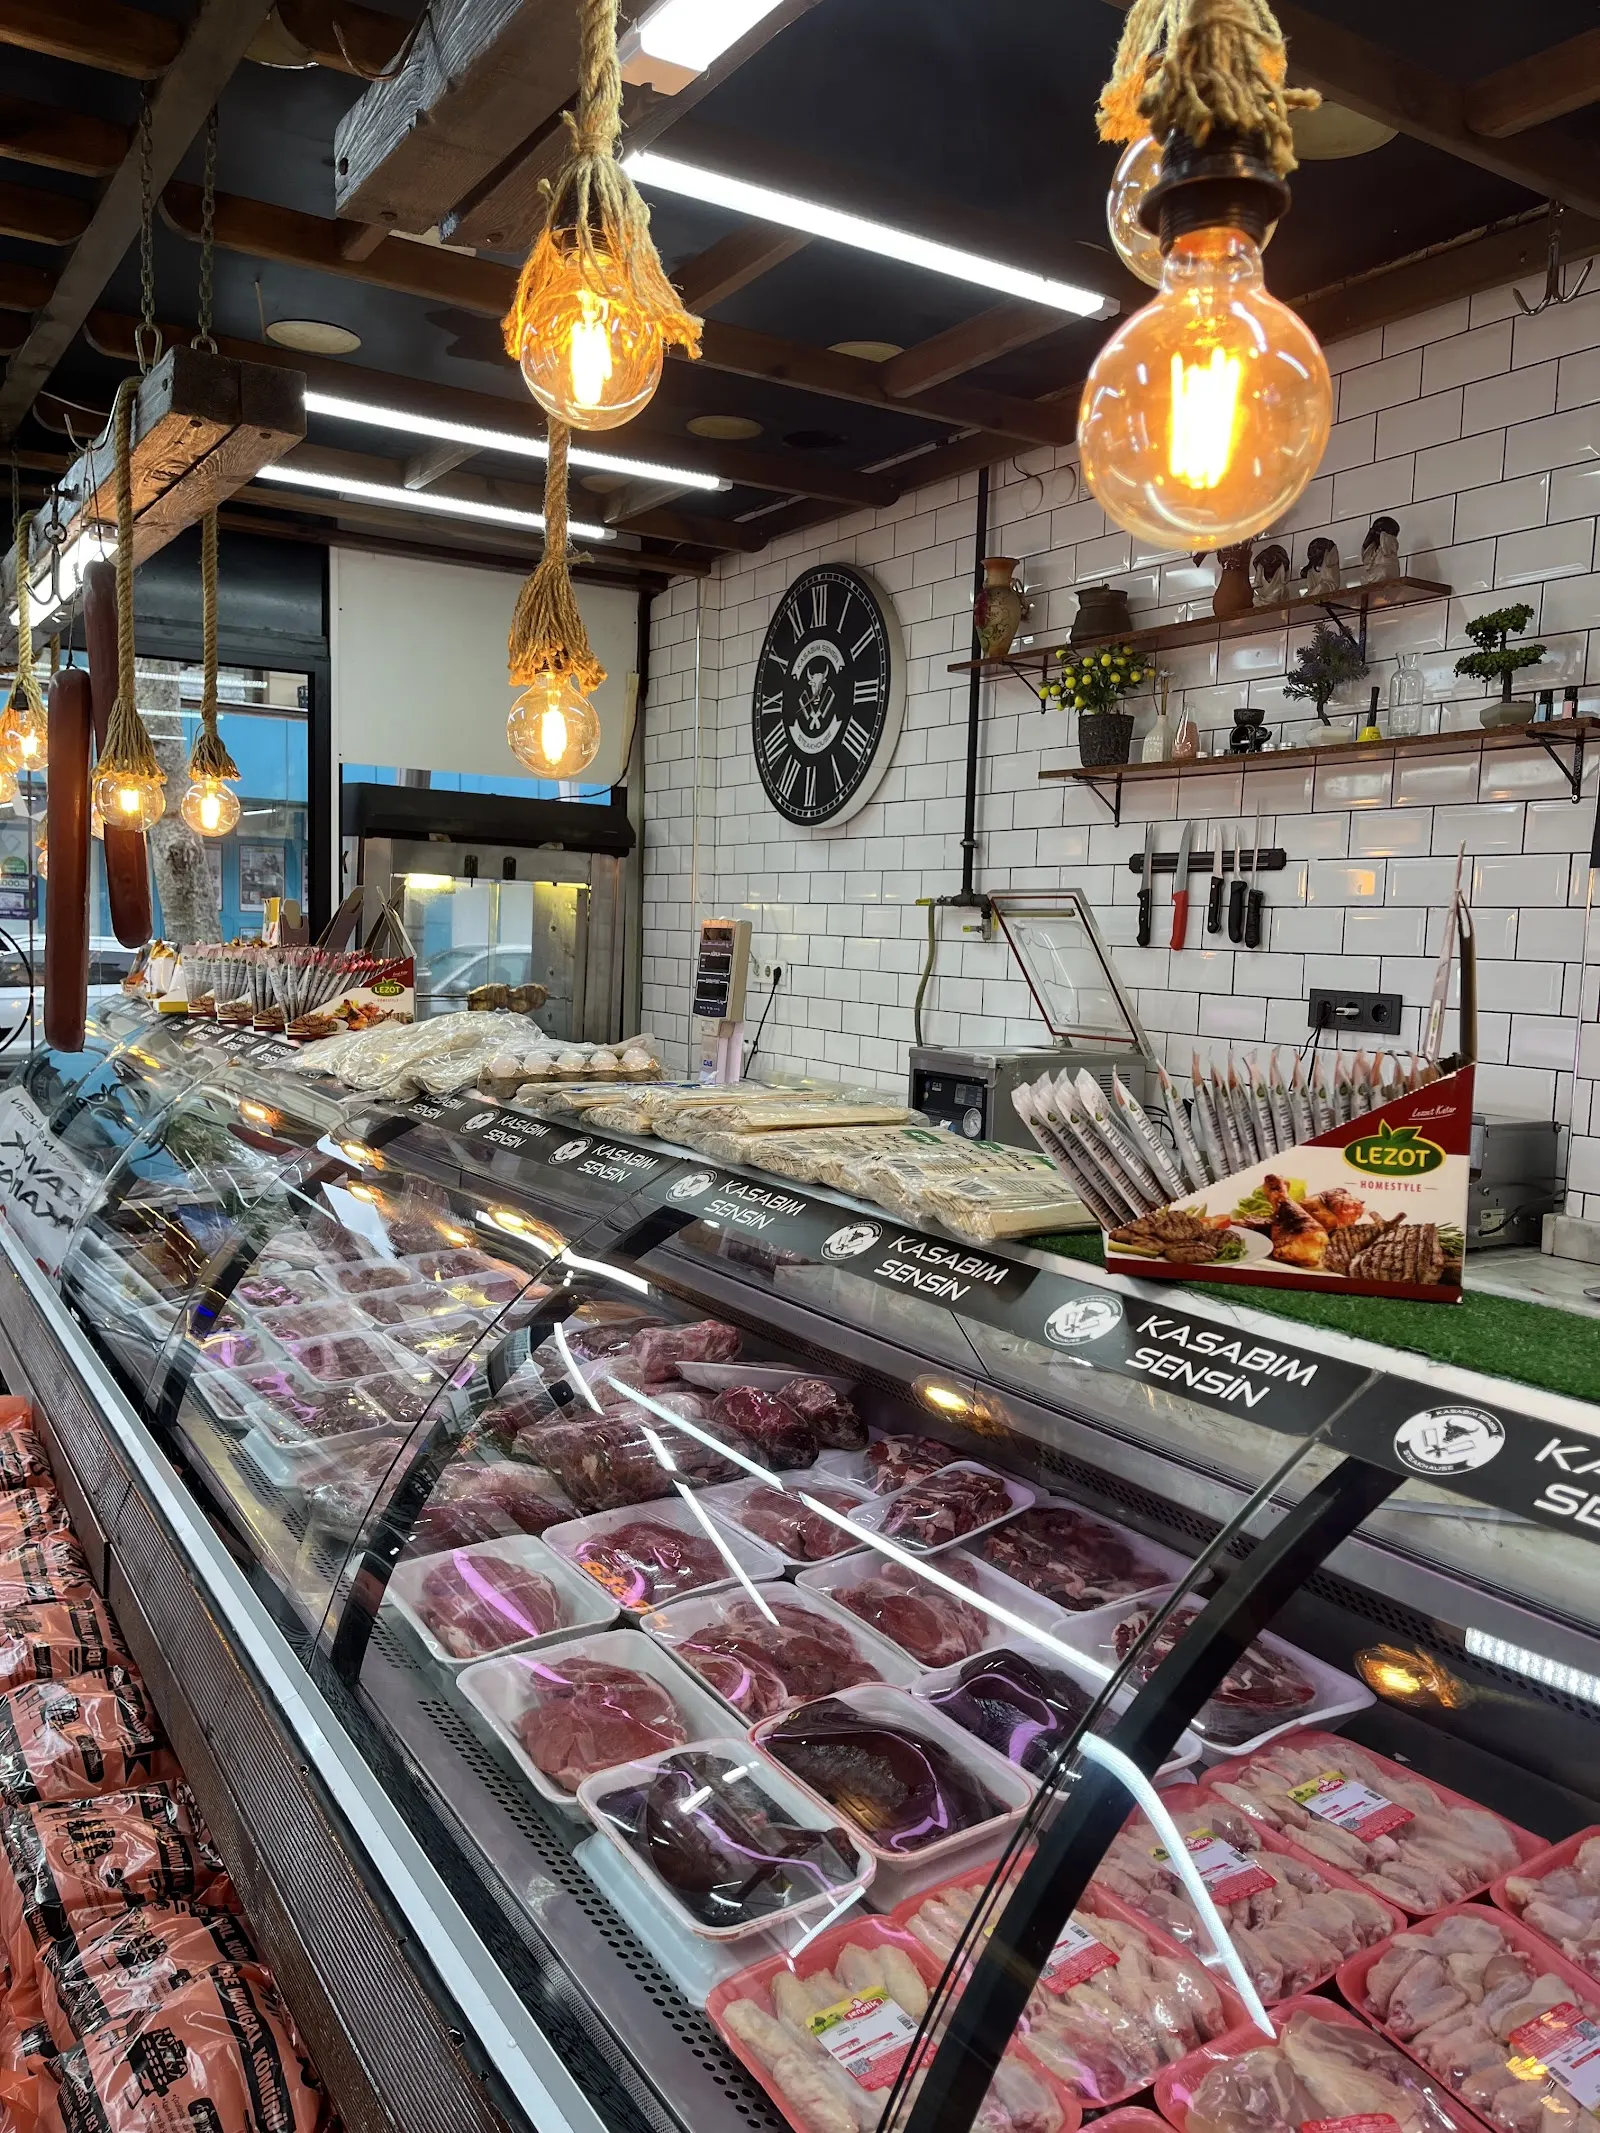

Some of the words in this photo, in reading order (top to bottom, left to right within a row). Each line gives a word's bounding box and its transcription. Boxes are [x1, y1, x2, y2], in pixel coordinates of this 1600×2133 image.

[787, 600, 806, 644] XI
[810, 584, 828, 628] XII
[837, 592, 852, 634] I
[769, 645, 789, 675] X
[850, 625, 876, 661] II
[762, 690, 784, 715] IX
[853, 678, 880, 705] III
[764, 719, 789, 770] VIII
[776, 754, 801, 801] VII
[803, 765, 817, 807] VI
[830, 754, 844, 793] V
[374, 986, 401, 994] LEZOT
[482, 1129, 527, 1149] SENSİN
[497, 1115, 551, 1138] KASABIM
[577, 1160, 632, 1183] SENSİN
[591, 1143, 659, 1171] KASABIM
[1355, 1145, 1431, 1168] LEZOT
[718, 1179, 807, 1217] KASABIM
[1360, 1180, 1422, 1193] HOMESTYLE
[704, 1199, 775, 1230] SENSİN
[887, 1235, 1010, 1285] KASABIM
[873, 1258, 971, 1302] SENSİN
[1136, 1314, 1319, 1387] KASABIM
[1125, 1347, 1270, 1408] SENSİN
[1435, 1407, 1479, 1418] KASABIM
[227, 1986, 264, 2052] MANGAL
[252, 2046, 288, 2132] KÖMÜRÜ
